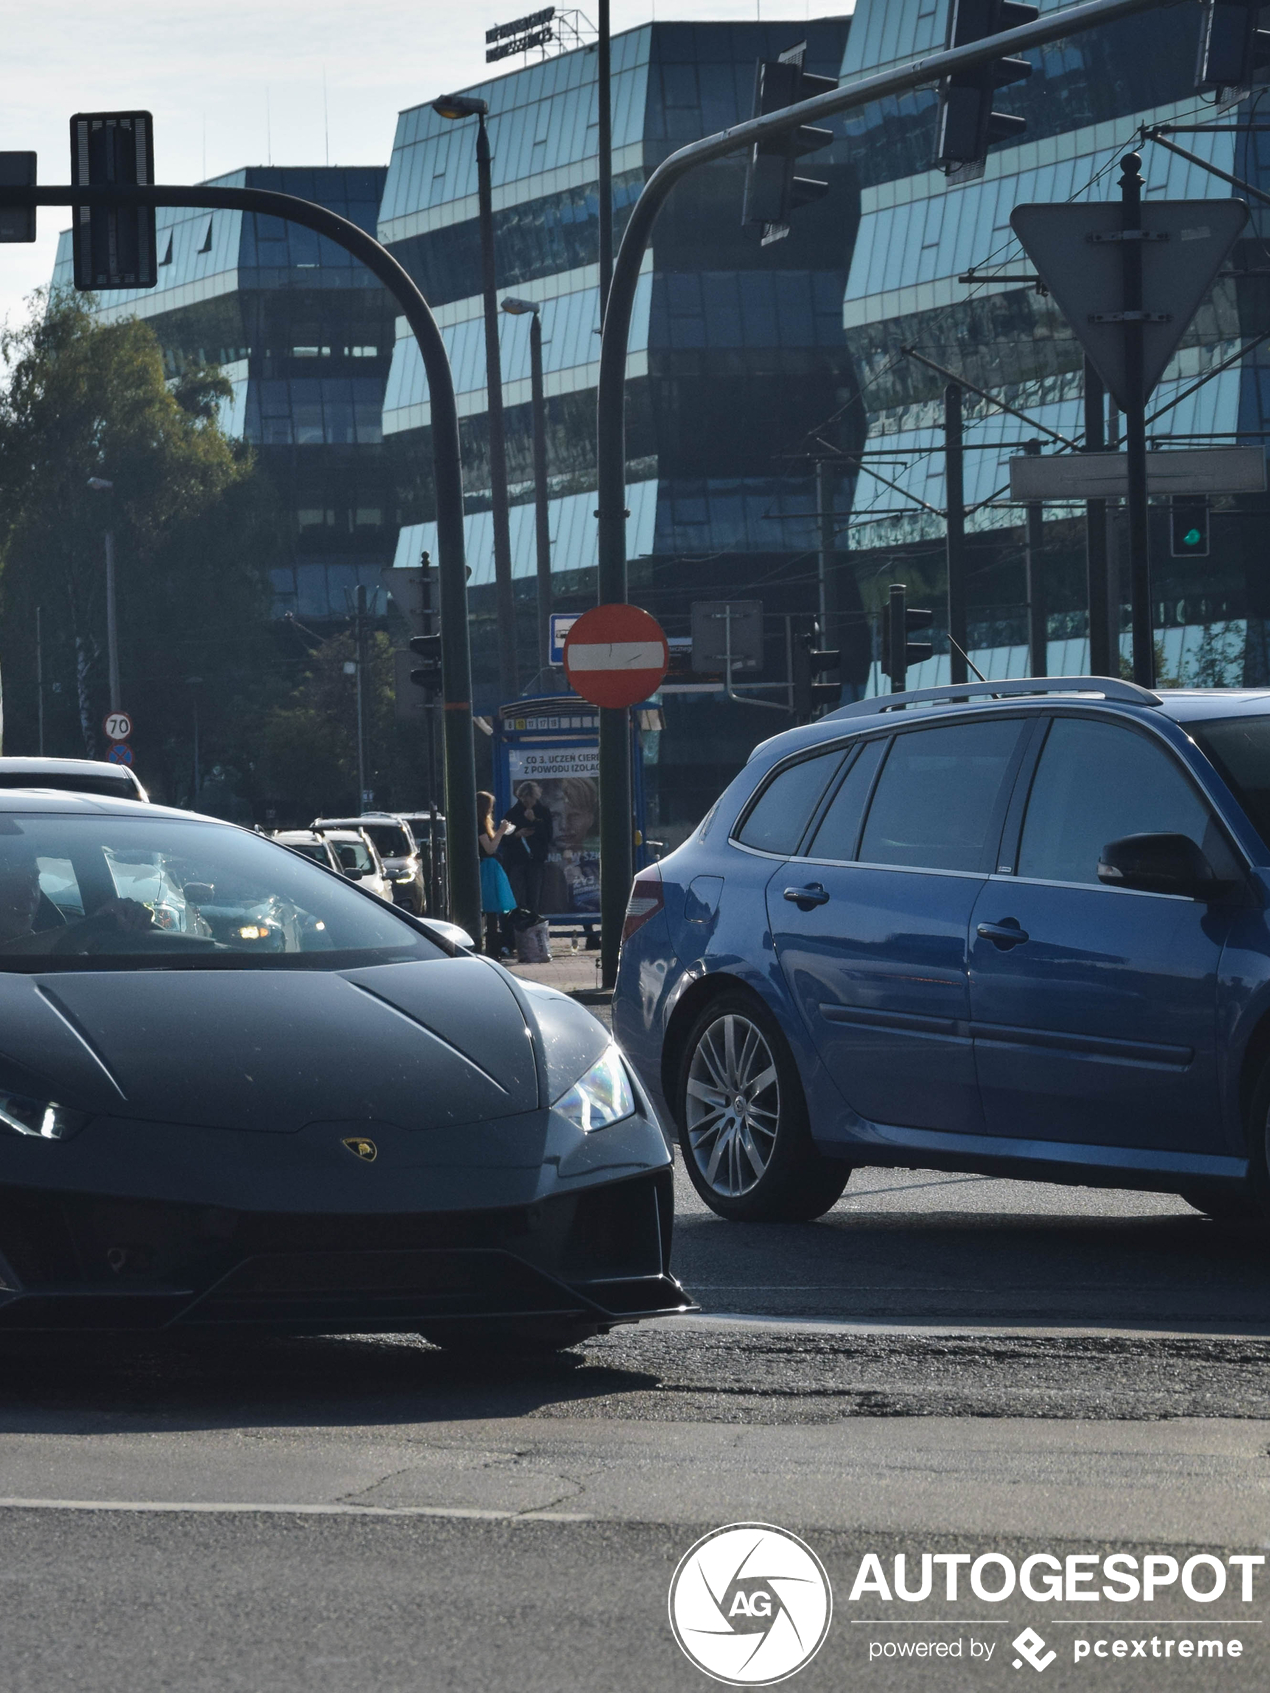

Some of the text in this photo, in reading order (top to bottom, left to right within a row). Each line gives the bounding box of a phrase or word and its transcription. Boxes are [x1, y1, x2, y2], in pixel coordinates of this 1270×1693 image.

[110, 719, 129, 734] 70
[526, 756, 537, 764] CO
[539, 755, 547, 764] 3.
[548, 752, 576, 763] UCZEŃ
[524, 766, 529, 774] Z
[531, 764, 569, 774] POWODU
